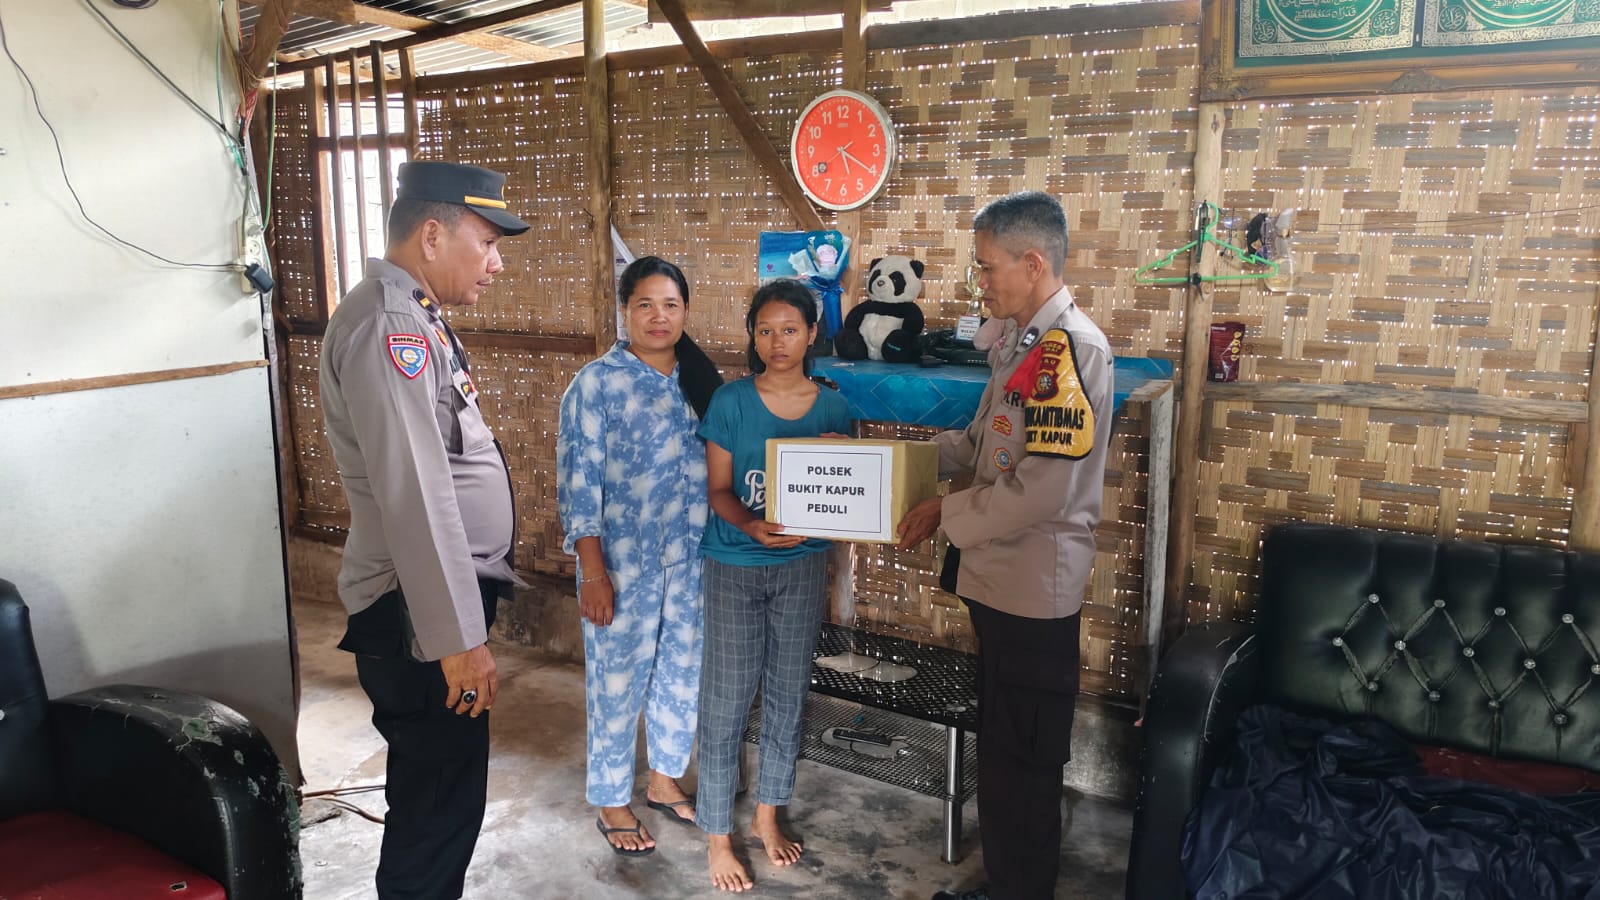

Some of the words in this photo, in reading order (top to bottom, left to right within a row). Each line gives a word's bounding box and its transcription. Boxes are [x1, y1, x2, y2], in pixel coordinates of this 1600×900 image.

[822, 111, 832, 125] 11
[836, 105, 849, 119] 12
[809, 126, 822, 140] 10
[867, 124, 876, 138] 2
[807, 145, 815, 158] 9
[872, 143, 880, 157] 3
[869, 164, 877, 177] 4
[824, 178, 832, 192] 7
[840, 183, 847, 196] 6
[856, 178, 864, 191] 5
[1040, 430, 1073, 446] KAPUR
[807, 466, 852, 476] POLSEK
[788, 484, 822, 494] BUKIT
[825, 485, 865, 496] KAPUR
[807, 503, 848, 514] PEDULI
